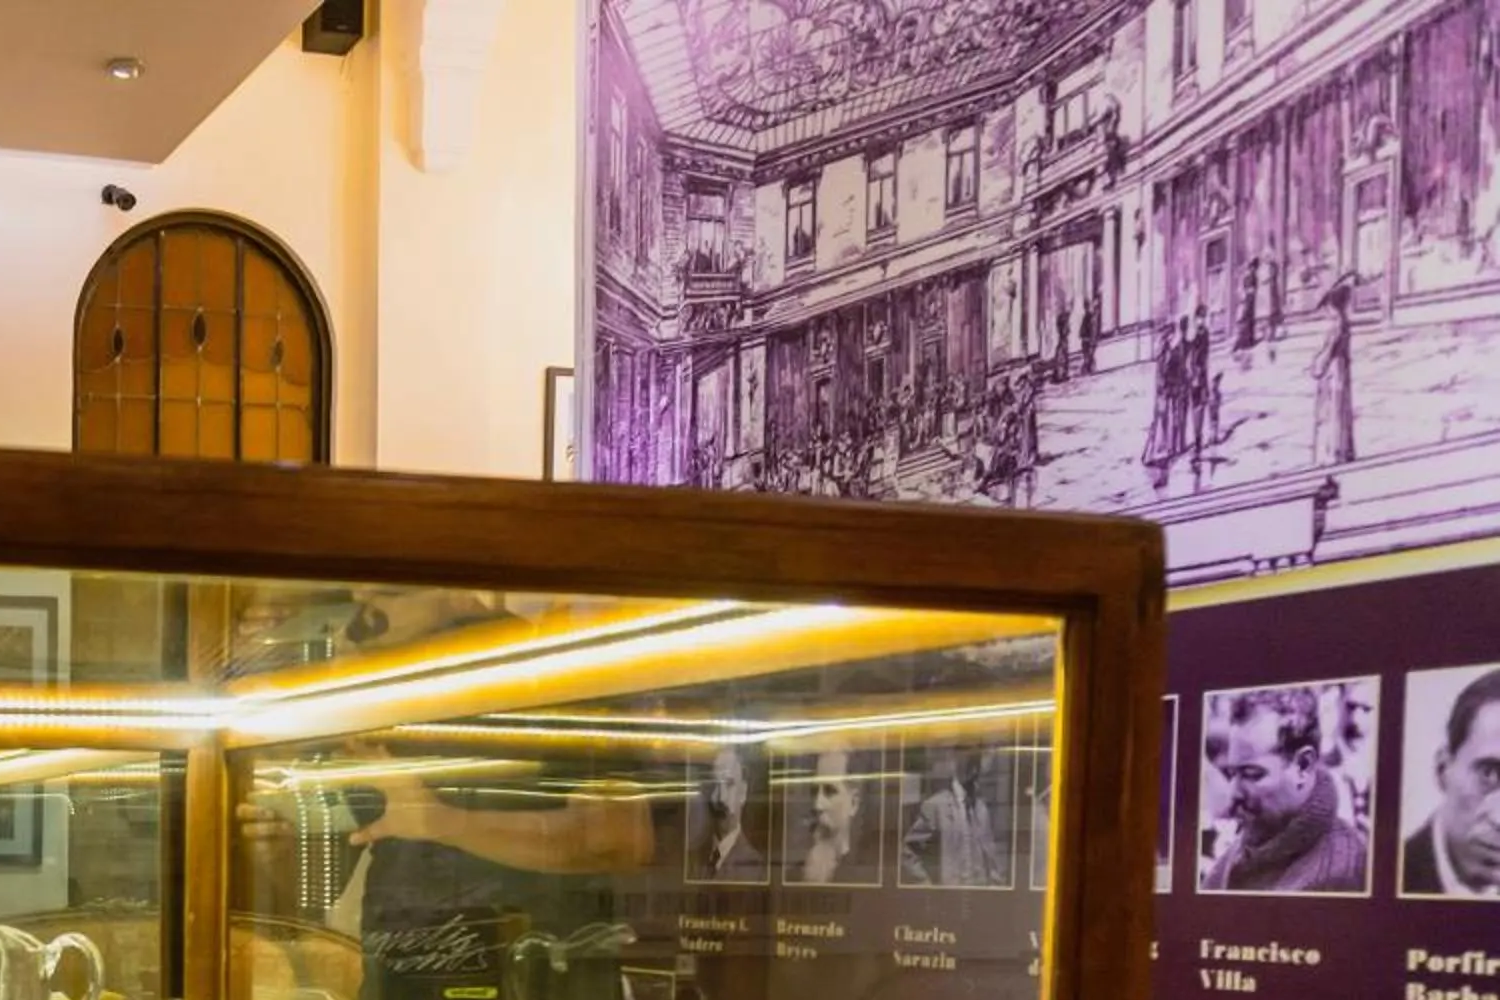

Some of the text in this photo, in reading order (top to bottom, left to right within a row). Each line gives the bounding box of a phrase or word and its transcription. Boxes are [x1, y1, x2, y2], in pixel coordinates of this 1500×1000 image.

[776, 919, 844, 938] Bernardo
[894, 925, 956, 944] Charles
[1200, 939, 1321, 966] Francisco
[1406, 949, 1500, 976] Porfir
[1199, 969, 1256, 993] Villa
